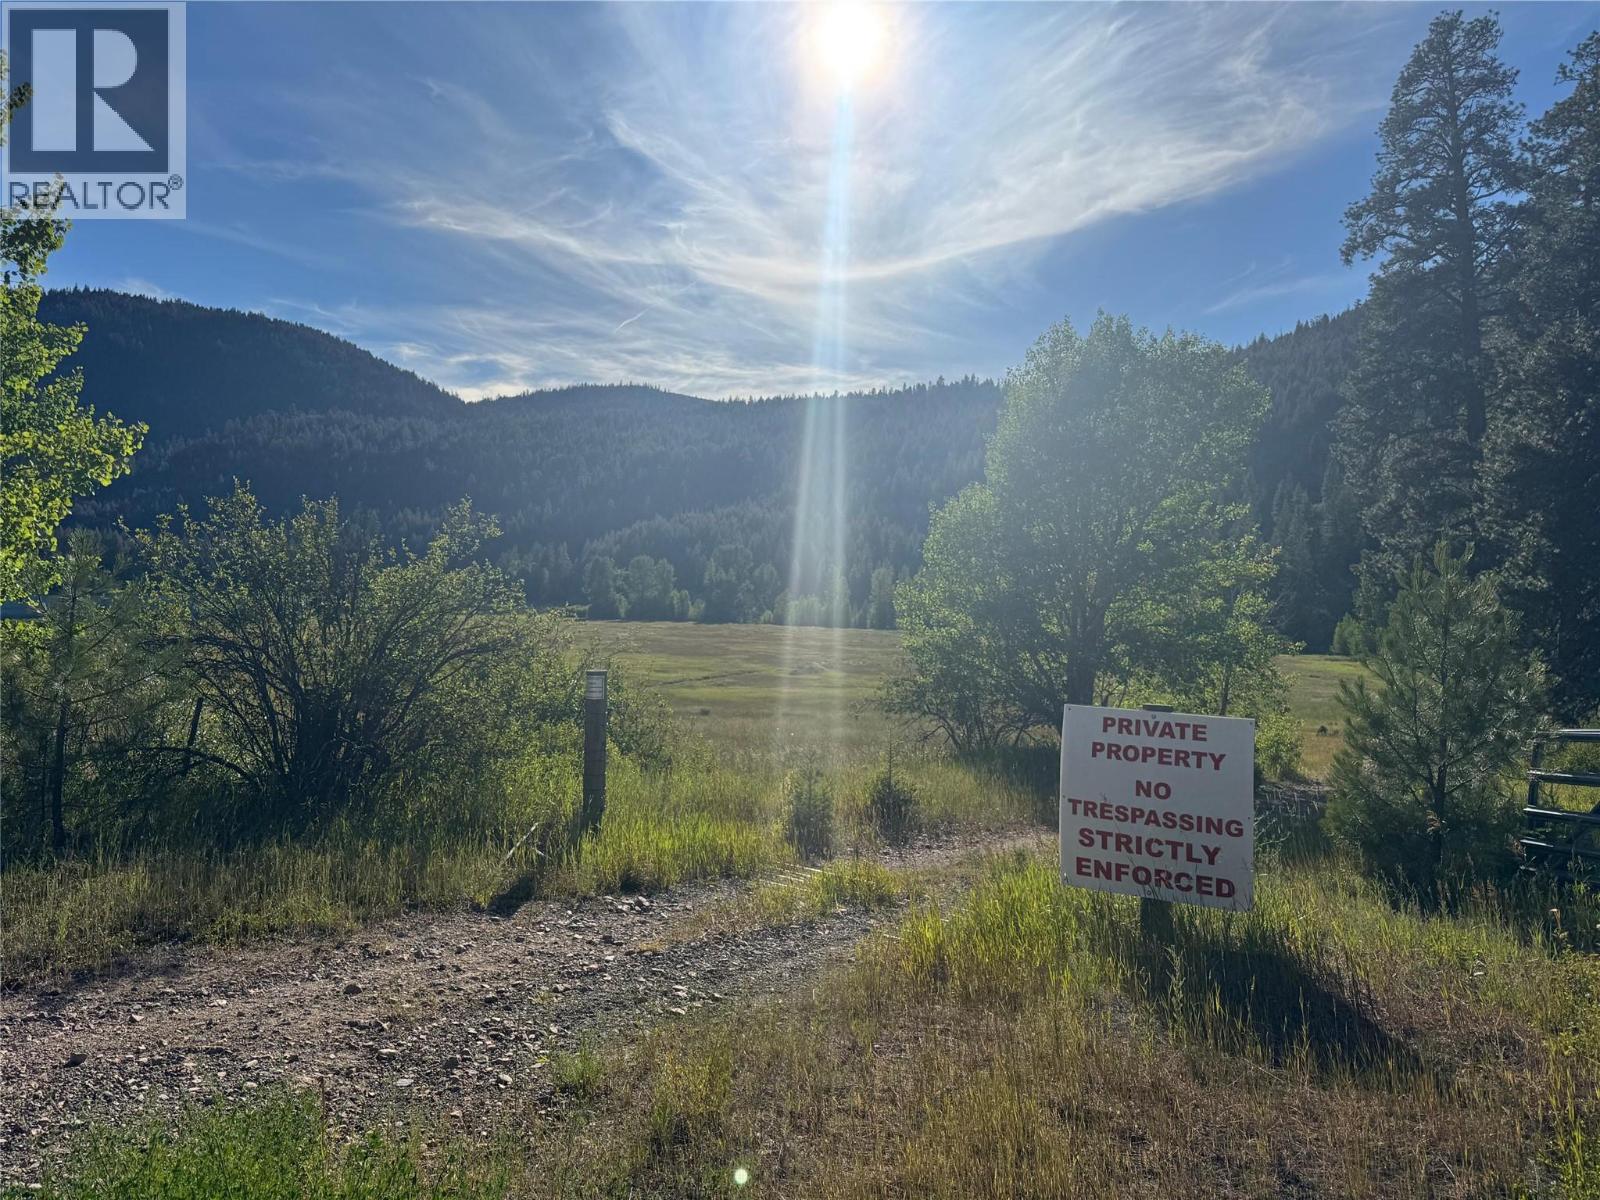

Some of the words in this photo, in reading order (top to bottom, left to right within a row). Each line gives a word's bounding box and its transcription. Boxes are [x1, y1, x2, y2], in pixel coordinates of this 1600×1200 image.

[1102, 716, 1208, 742] PRIVATE
[1091, 741, 1226, 771] PROPERTY
[1135, 779, 1172, 800] NO
[1068, 798, 1244, 837] TRESPASSING
[1078, 827, 1221, 866] STRICTLY
[1075, 856, 1235, 898] ENFORCED
